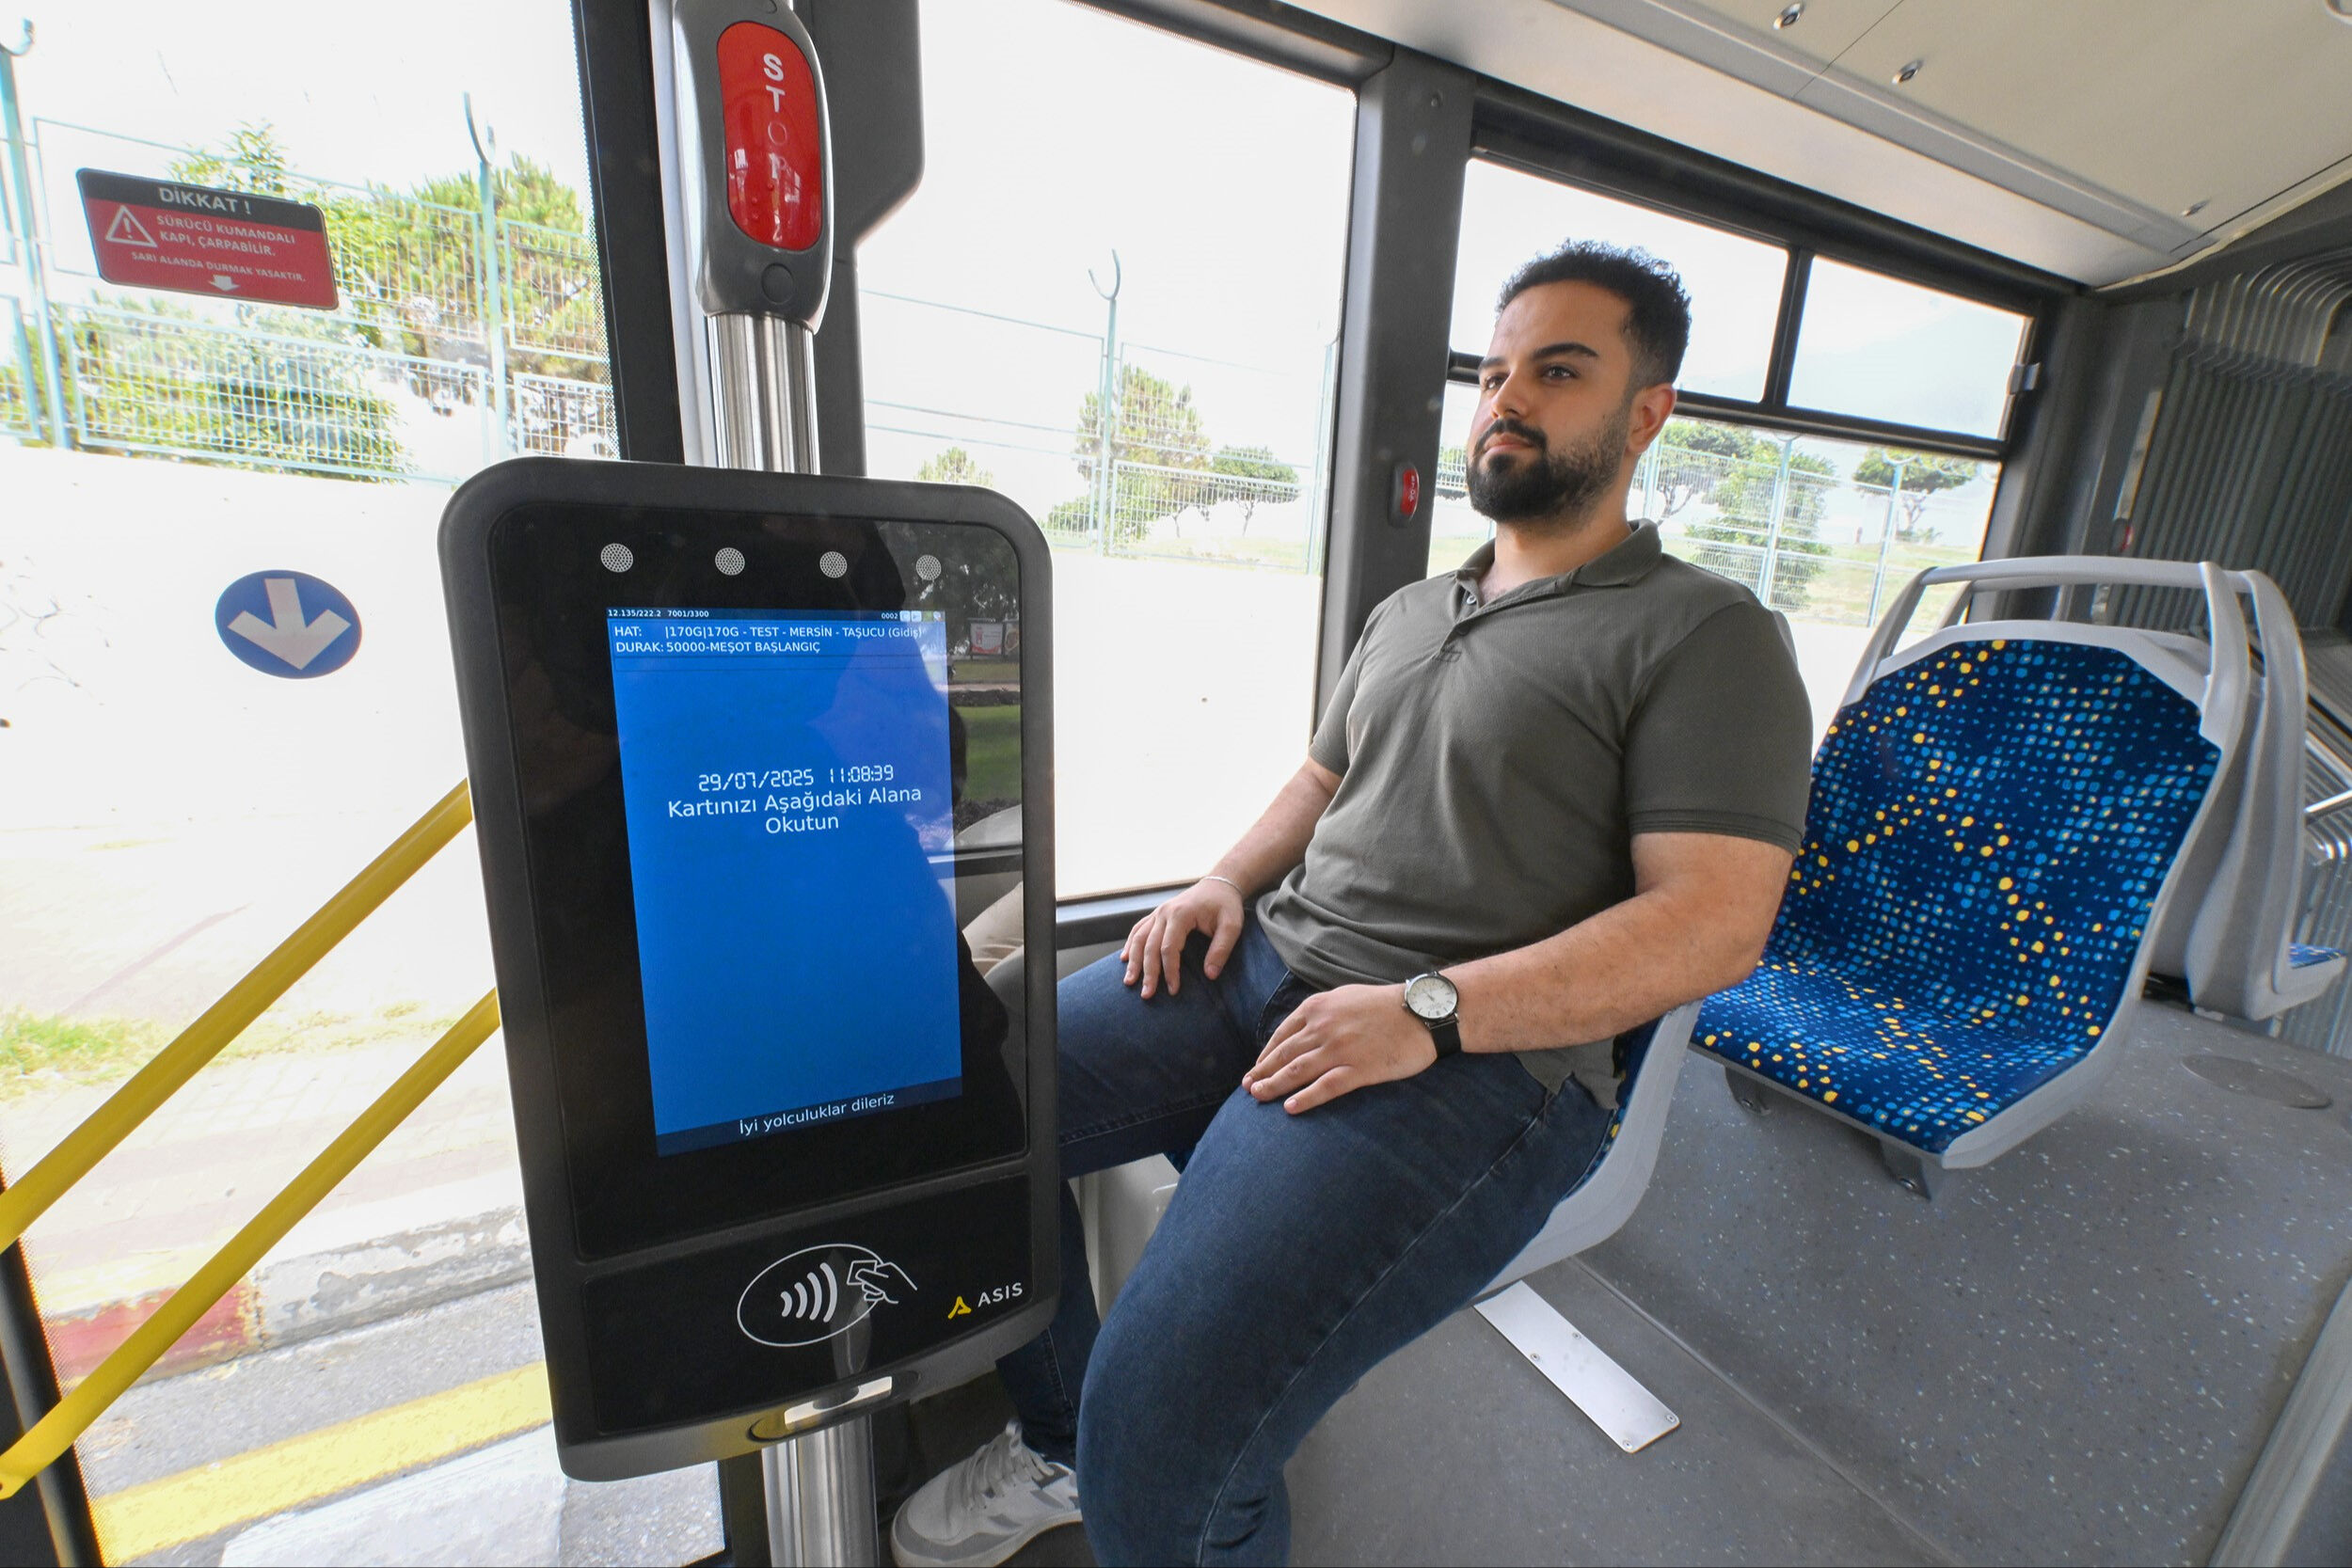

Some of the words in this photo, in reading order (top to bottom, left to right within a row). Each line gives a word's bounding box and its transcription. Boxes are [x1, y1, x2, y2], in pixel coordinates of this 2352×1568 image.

[159, 186, 238, 213] DİKKAT
[156, 214, 213, 232] SÜRÜCÜ
[215, 224, 296, 245] KUMANDALI
[198, 235, 277, 257] ÇARPABİLİR.
[132, 251, 157, 262] SARI
[160, 255, 204, 269] ALANDA
[206, 261, 253, 276] DURMAK
[256, 268, 307, 282] YASAKTIR.
[608, 610, 661, 618] 12.135/222.2
[667, 610, 709, 618] 7001/3300
[614, 626, 643, 637] HAT:
[750, 626, 780, 638] TEST
[789, 625, 833, 638] MERSİN
[842, 627, 885, 639] TAŞUCU
[616, 641, 664, 653] DURAK:
[755, 641, 820, 654] BAŞLANGIÇ
[698, 768, 815, 792] 29/07/2025
[830, 764, 894, 784] 11:08:39
[668, 798, 756, 818] Kartınızı
[764, 788, 863, 814] Aşağıdaki
[868, 787, 922, 804] Alana
[765, 816, 839, 834] Okutun
[739, 1119, 758, 1136] İyi
[763, 1102, 847, 1132] yolculuklar
[851, 1093, 895, 1112] dileriz
[977, 1282, 1024, 1308] ASIS
